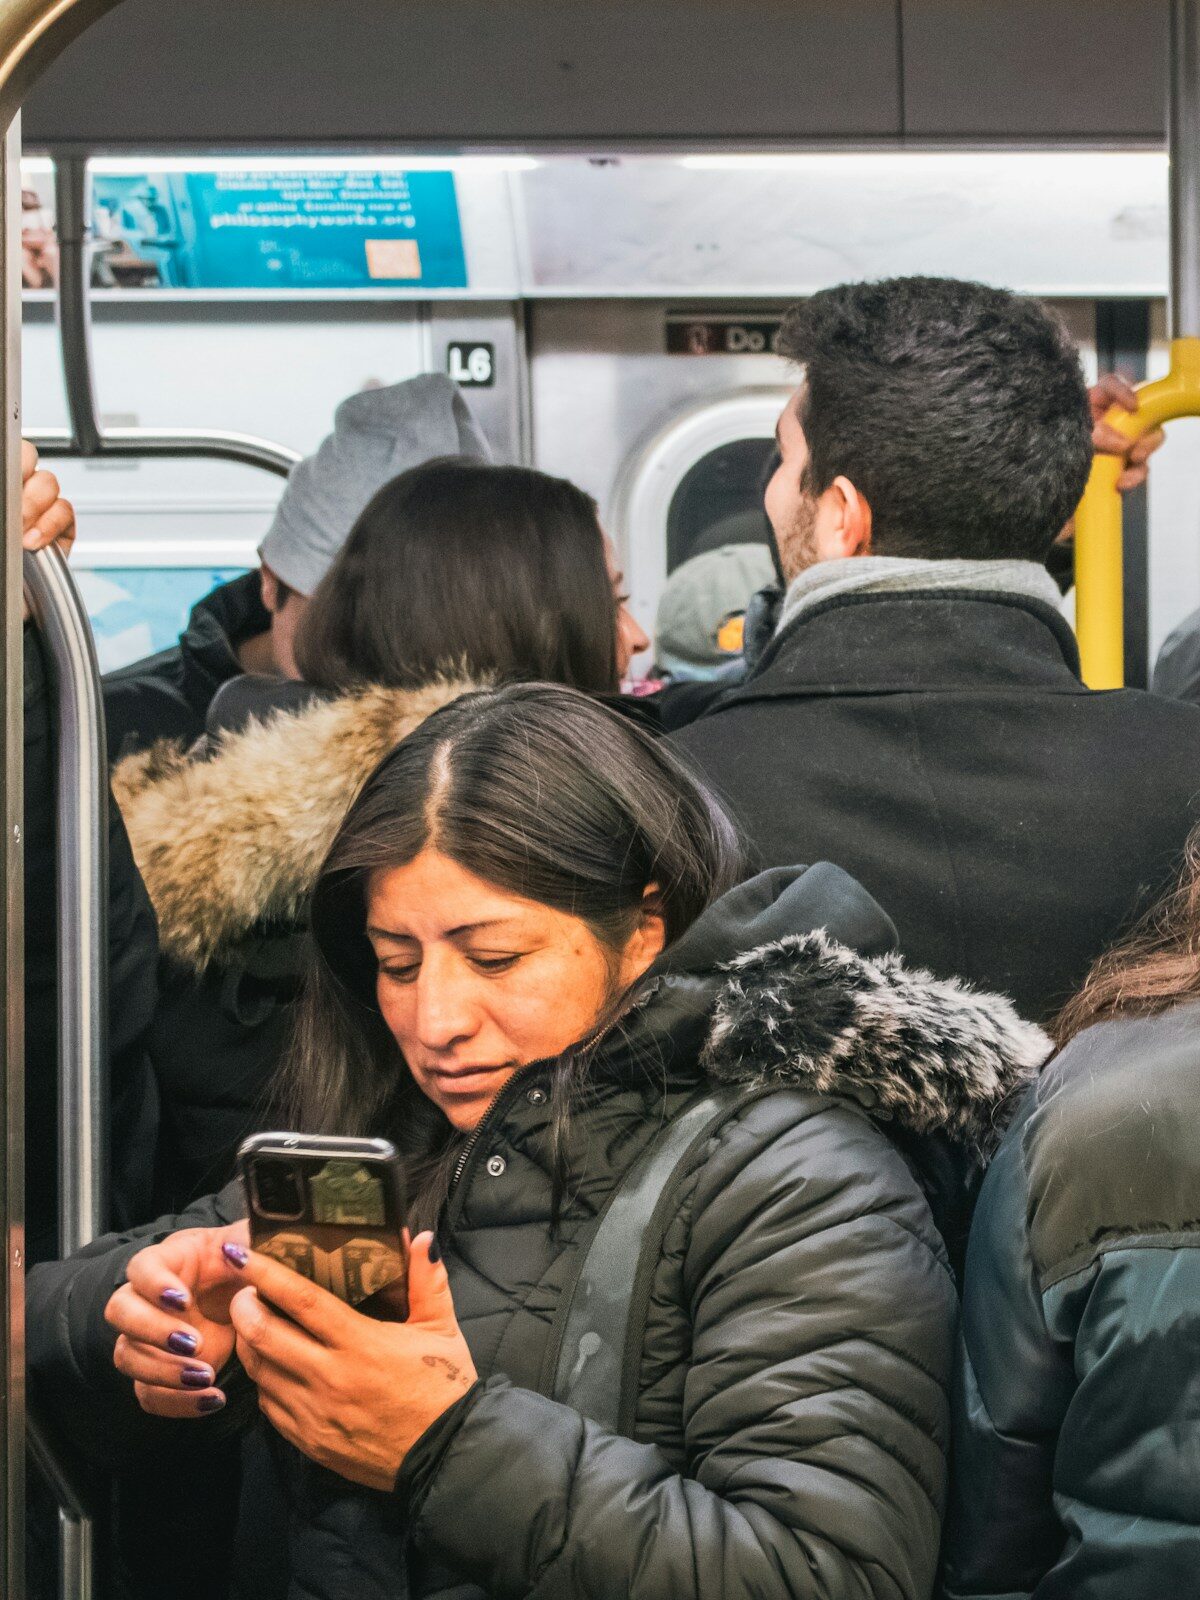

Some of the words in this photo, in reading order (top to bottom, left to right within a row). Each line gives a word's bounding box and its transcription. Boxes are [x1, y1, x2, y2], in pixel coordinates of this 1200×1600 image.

[210, 212, 416, 229] philosophyworks.org
[726, 326, 765, 350] Do
[449, 347, 491, 381] L6
